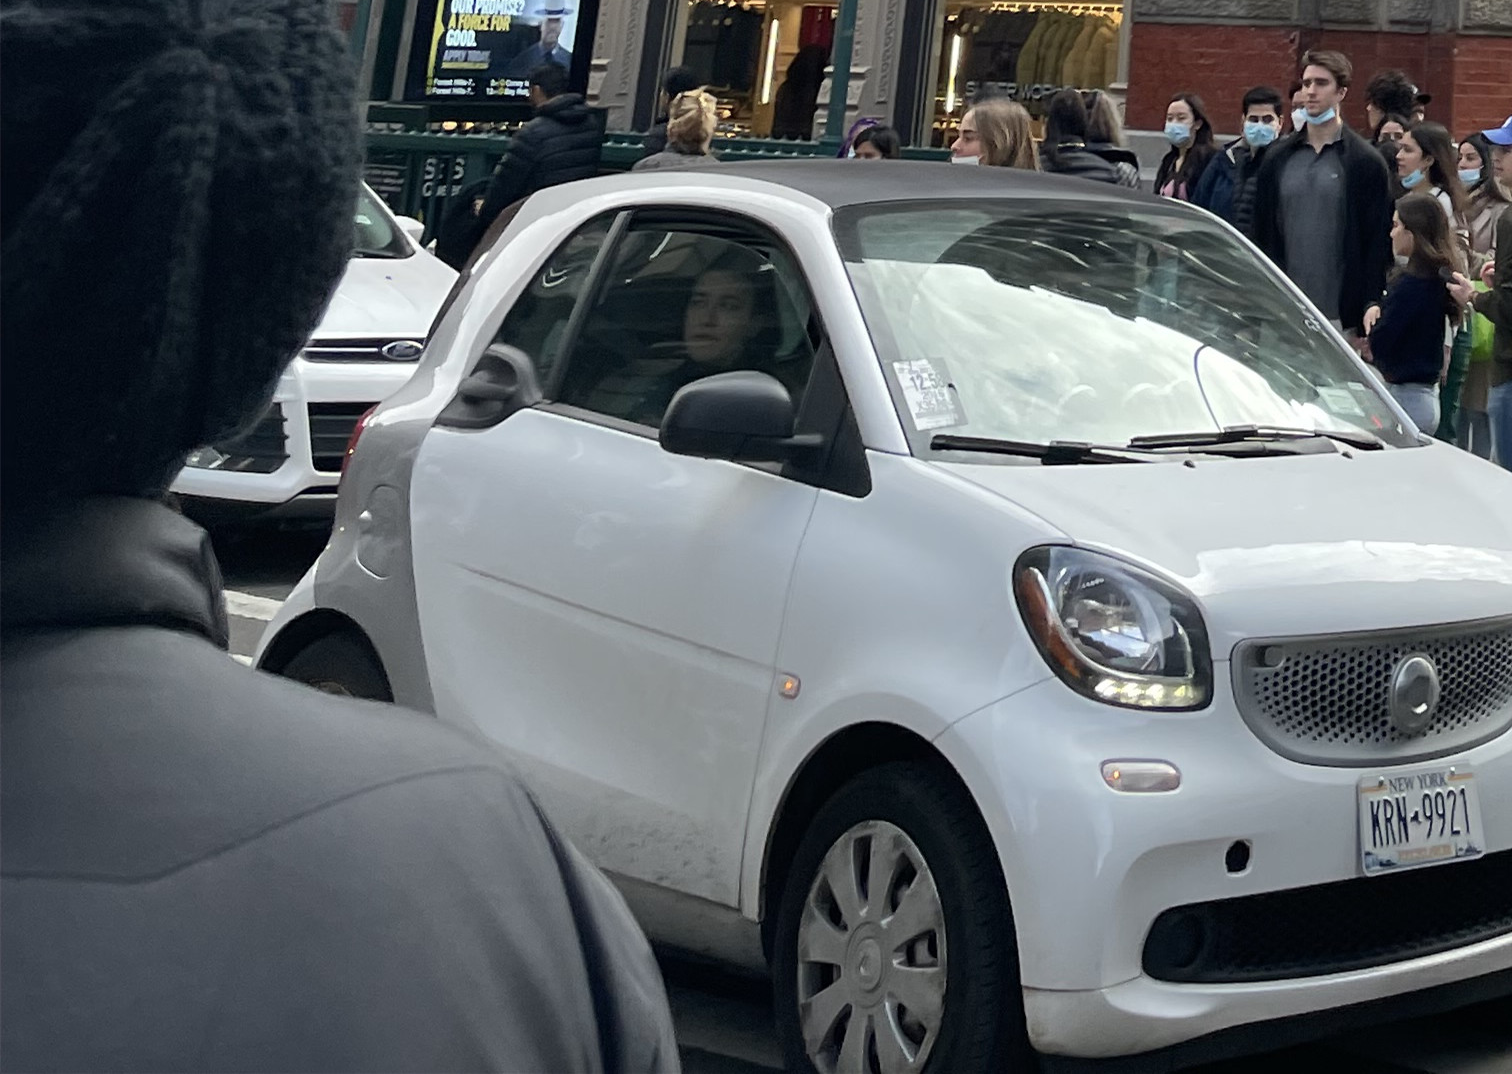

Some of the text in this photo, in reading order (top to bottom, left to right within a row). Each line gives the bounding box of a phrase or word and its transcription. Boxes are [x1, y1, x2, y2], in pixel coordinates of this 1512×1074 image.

[447, 14, 513, 32] A FORCE FOR
[445, 30, 478, 47] GOOD.
[1388, 772, 1448, 793] NEW YORK
